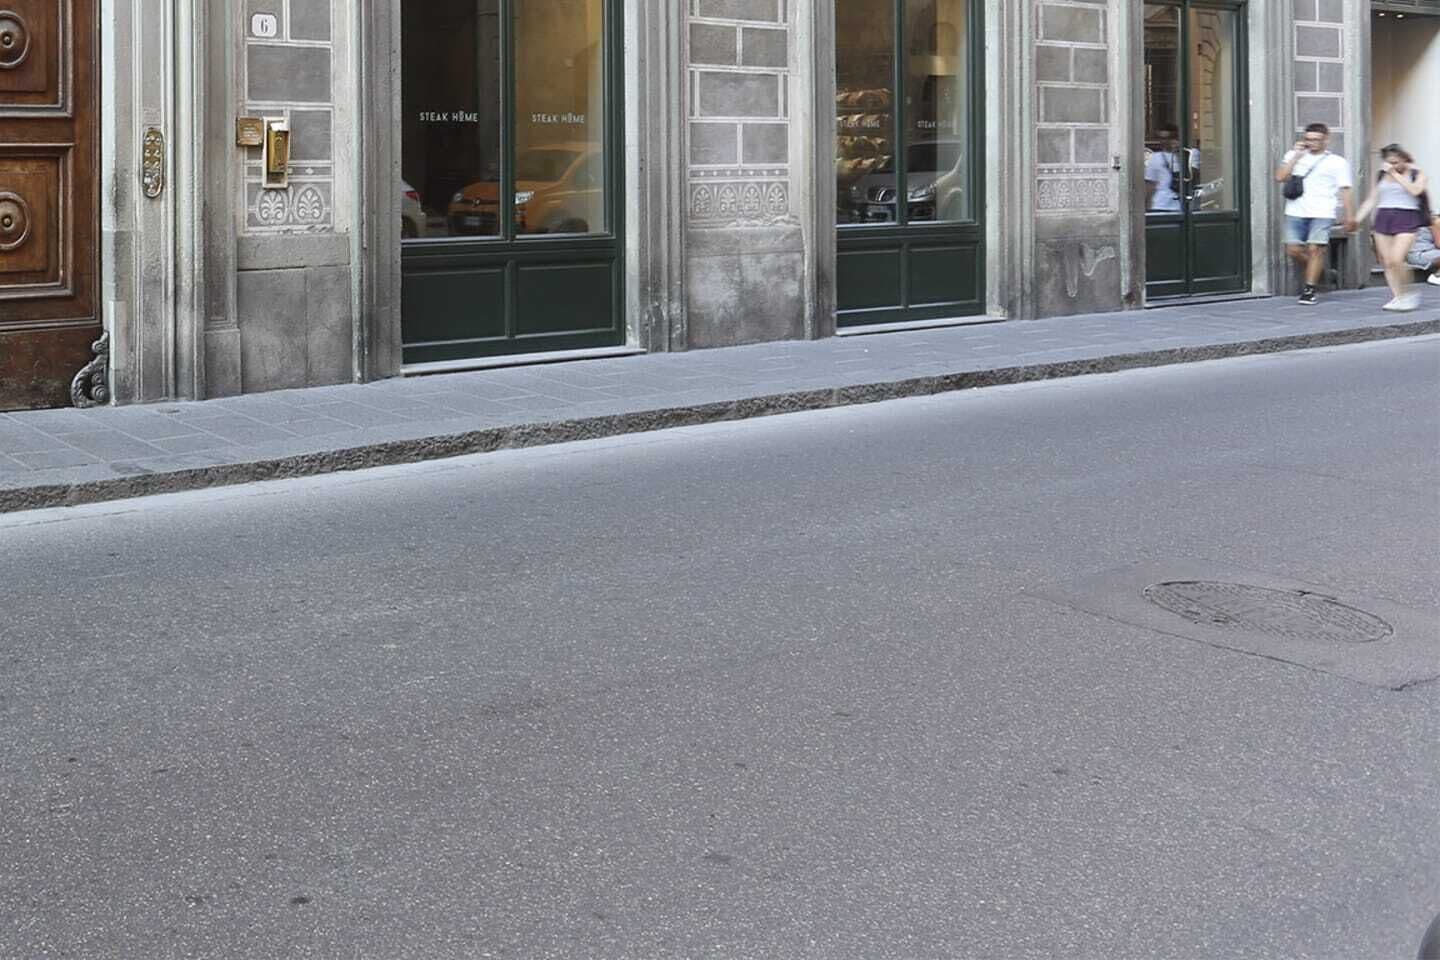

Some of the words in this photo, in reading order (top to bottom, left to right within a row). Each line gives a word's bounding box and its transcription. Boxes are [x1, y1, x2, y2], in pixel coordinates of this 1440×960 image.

[260, 18, 269, 34] 6
[419, 111, 448, 122] STEAK
[532, 113, 558, 124] STEAK
